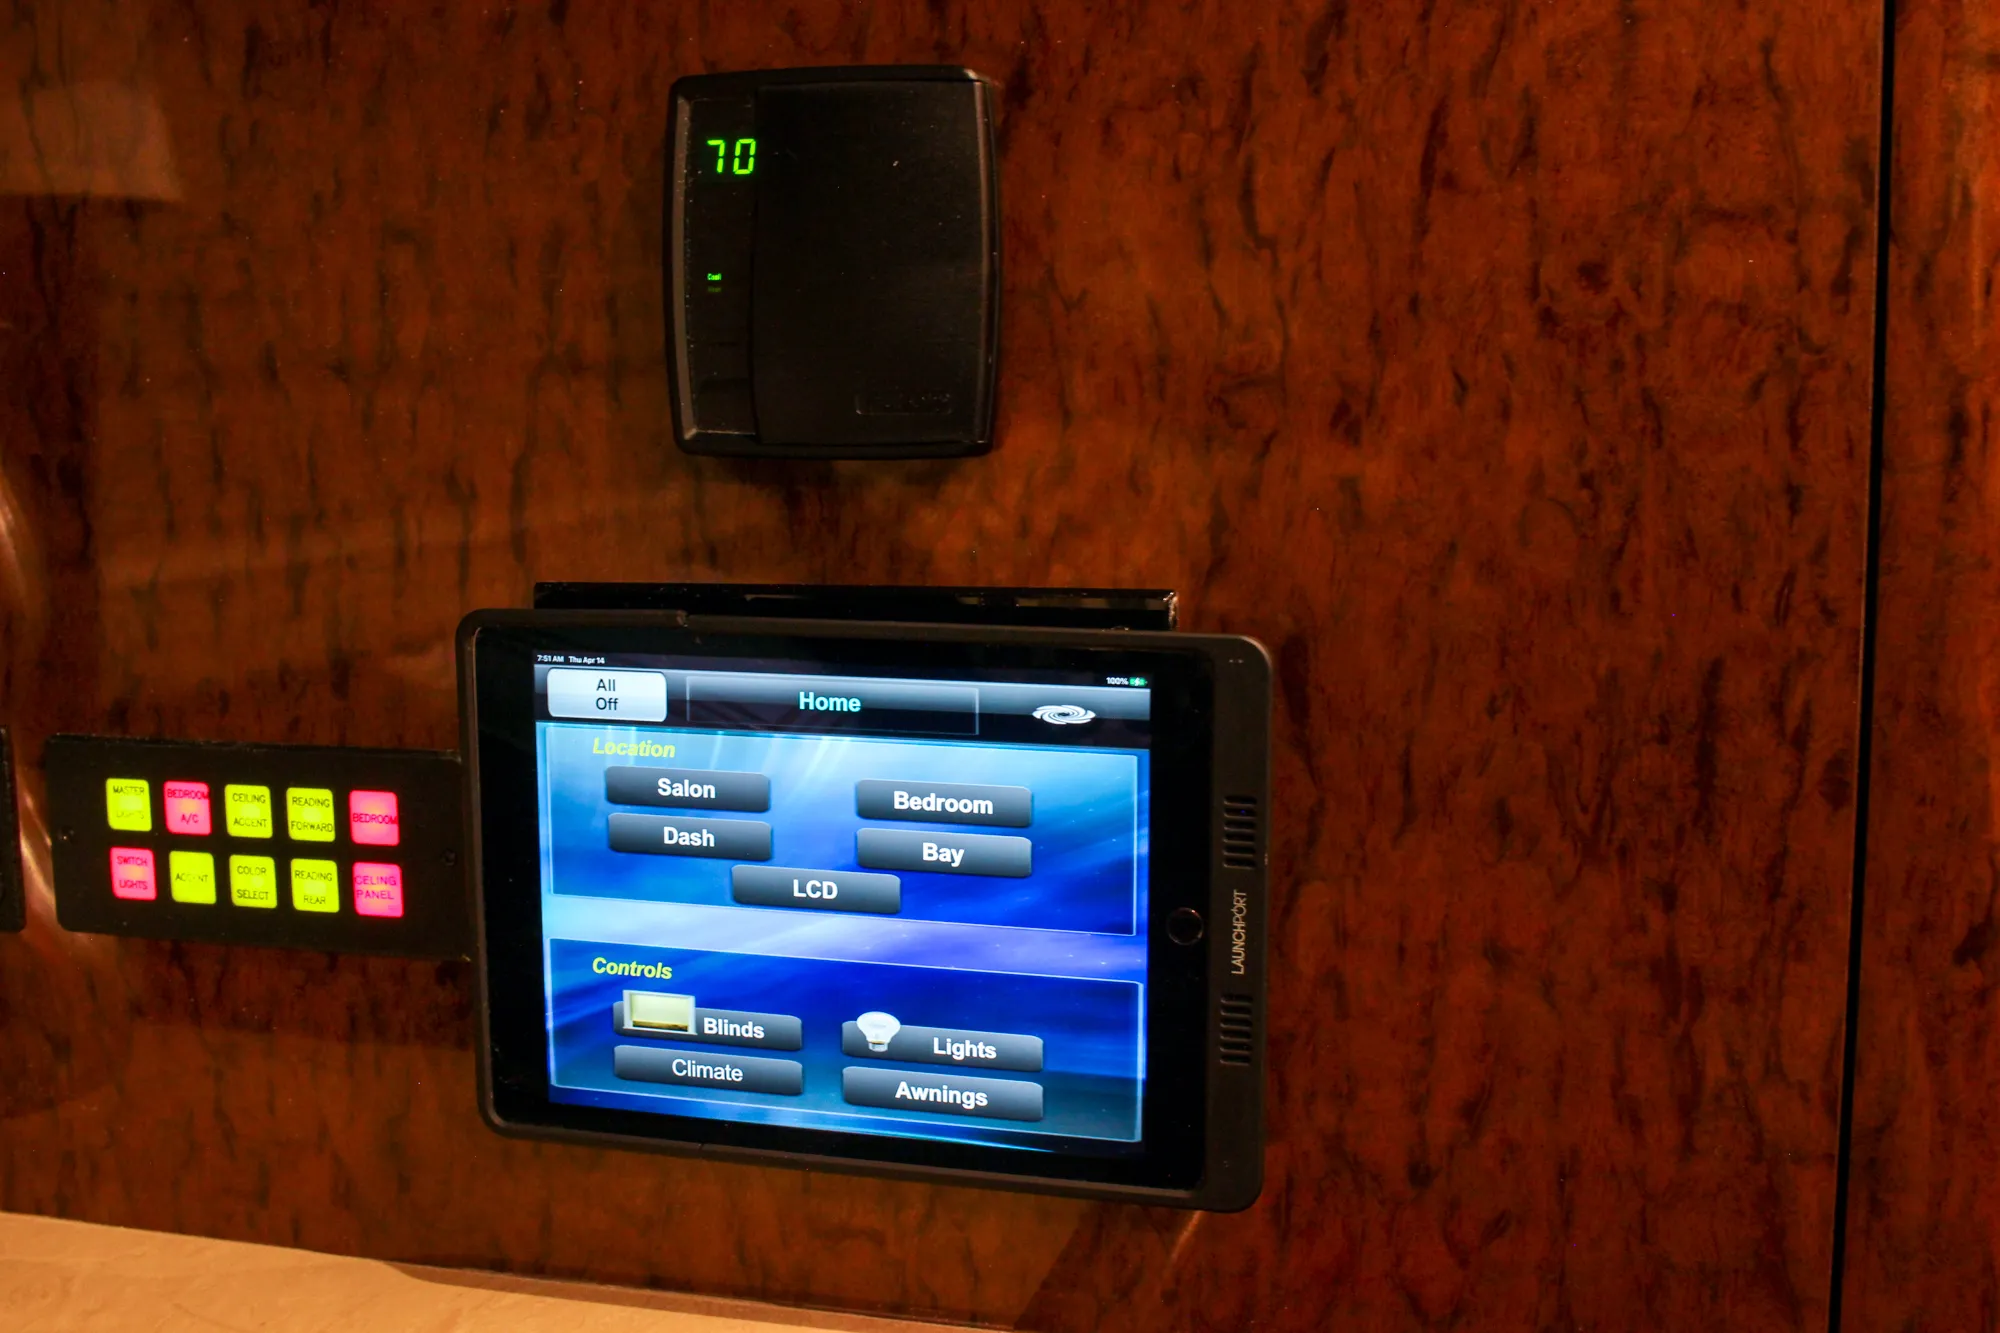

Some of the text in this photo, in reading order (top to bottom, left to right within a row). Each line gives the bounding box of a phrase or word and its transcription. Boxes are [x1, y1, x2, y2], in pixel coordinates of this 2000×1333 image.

[706, 138, 757, 175] 70
[537, 654, 552, 662] 7:51
[552, 655, 565, 663] AM
[568, 655, 582, 664] Thu
[583, 656, 596, 665] Apr
[596, 678, 616, 692] All
[1106, 676, 1129, 686] 100%
[595, 697, 619, 712] Off
[798, 690, 862, 713] Home
[592, 737, 676, 759] Location
[112, 785, 145, 796] MASTER
[167, 787, 210, 800] BEDROOM
[657, 777, 716, 799] Salon
[232, 792, 266, 804] CEILING
[292, 796, 330, 808] READING
[893, 790, 994, 815] Bedroom
[116, 810, 145, 820] LIS
[180, 812, 199, 824] A/C
[352, 812, 398, 825] BEDROOM
[233, 818, 268, 829] ACCENT
[290, 820, 334, 833] FORWARD
[663, 826, 715, 847] Dash
[116, 855, 148, 867] SWITCH
[922, 842, 965, 868] Bay
[236, 865, 267, 876] COLOR
[294, 869, 333, 882] READING
[175, 872, 209, 883] ACNT
[354, 875, 397, 886] CELING
[119, 879, 148, 891] LIGHTS
[792, 879, 839, 900] LCD
[236, 889, 269, 901] SELECT
[303, 895, 326, 905] REAR
[356, 889, 395, 900] PANEL
[1230, 889, 1247, 975] LAUNCHPORT
[592, 956, 673, 980] Controls
[703, 1017, 766, 1040] Blinds
[932, 1036, 998, 1061] Lights
[671, 1058, 744, 1083] Climate
[894, 1080, 989, 1110] Awnings
